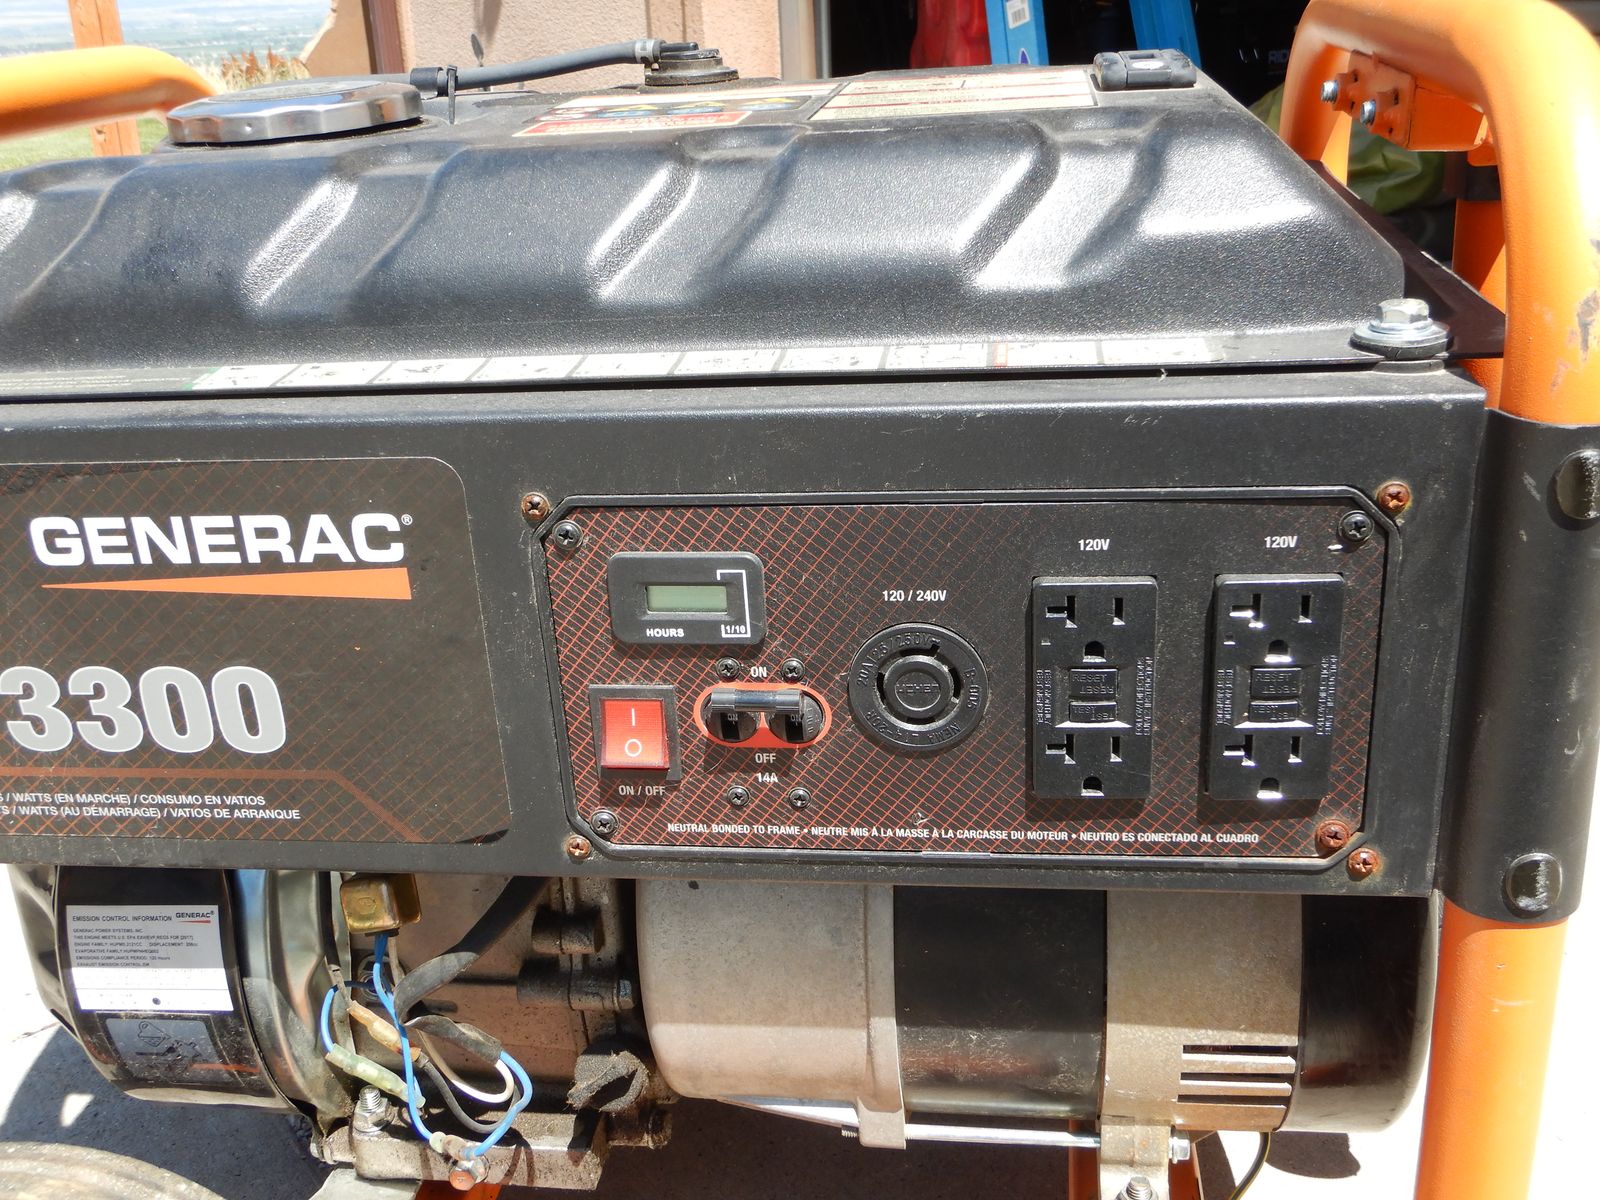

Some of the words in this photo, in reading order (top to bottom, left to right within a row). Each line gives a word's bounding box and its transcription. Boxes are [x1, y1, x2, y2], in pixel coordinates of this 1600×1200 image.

[1078, 539, 1110, 551] 120V
[1264, 536, 1297, 548] 120V
[882, 590, 904, 602] 120
[916, 590, 947, 602] 240V
[646, 628, 684, 638] HOURS
[725, 625, 746, 634] 1/10
[751, 667, 768, 678] ON
[1072, 674, 1107, 683] RESET
[0, 666, 286, 753] 3300
[755, 753, 776, 764] OFF
[756, 772, 779, 783] 14A
[618, 785, 634, 796] ON
[645, 786, 666, 796] OFF
[12, 793, 53, 802] WATTS
[54, 794, 74, 804] (EN
[76, 794, 131, 805] MARCHE)
[139, 795, 202, 805] CONSUMO
[205, 796, 221, 805] EN
[222, 796, 266, 806] VATIOS
[18, 806, 58, 816] WATTS
[60, 806, 80, 817] (AU
[82, 804, 161, 818] DÉMARRAGE)
[169, 808, 212, 818] VATIOS
[215, 809, 231, 818] DE
[233, 809, 300, 820] ARRANQUE
[667, 823, 709, 833] NEUTRAL
[712, 824, 751, 834] BONDED
[752, 825, 765, 834] TO
[767, 825, 800, 835] FRAME
[811, 827, 848, 836] NEUTRE
[850, 827, 869, 837] MIS
[871, 826, 878, 837] À
[880, 828, 893, 837] LA
[895, 828, 930, 838] MASSE
[932, 827, 939, 839] À
[941, 829, 955, 839] LA
[956, 830, 1008, 840] CARCASSE
[1010, 831, 1025, 840] DU
[1027, 831, 1068, 841] MOTEUR
[1079, 831, 1120, 842] NEUTRO
[1121, 832, 1135, 842] ES
[1137, 833, 1198, 843] CONECTADO
[1200, 833, 1214, 843] AL
[1215, 833, 1259, 844] CUADRO
